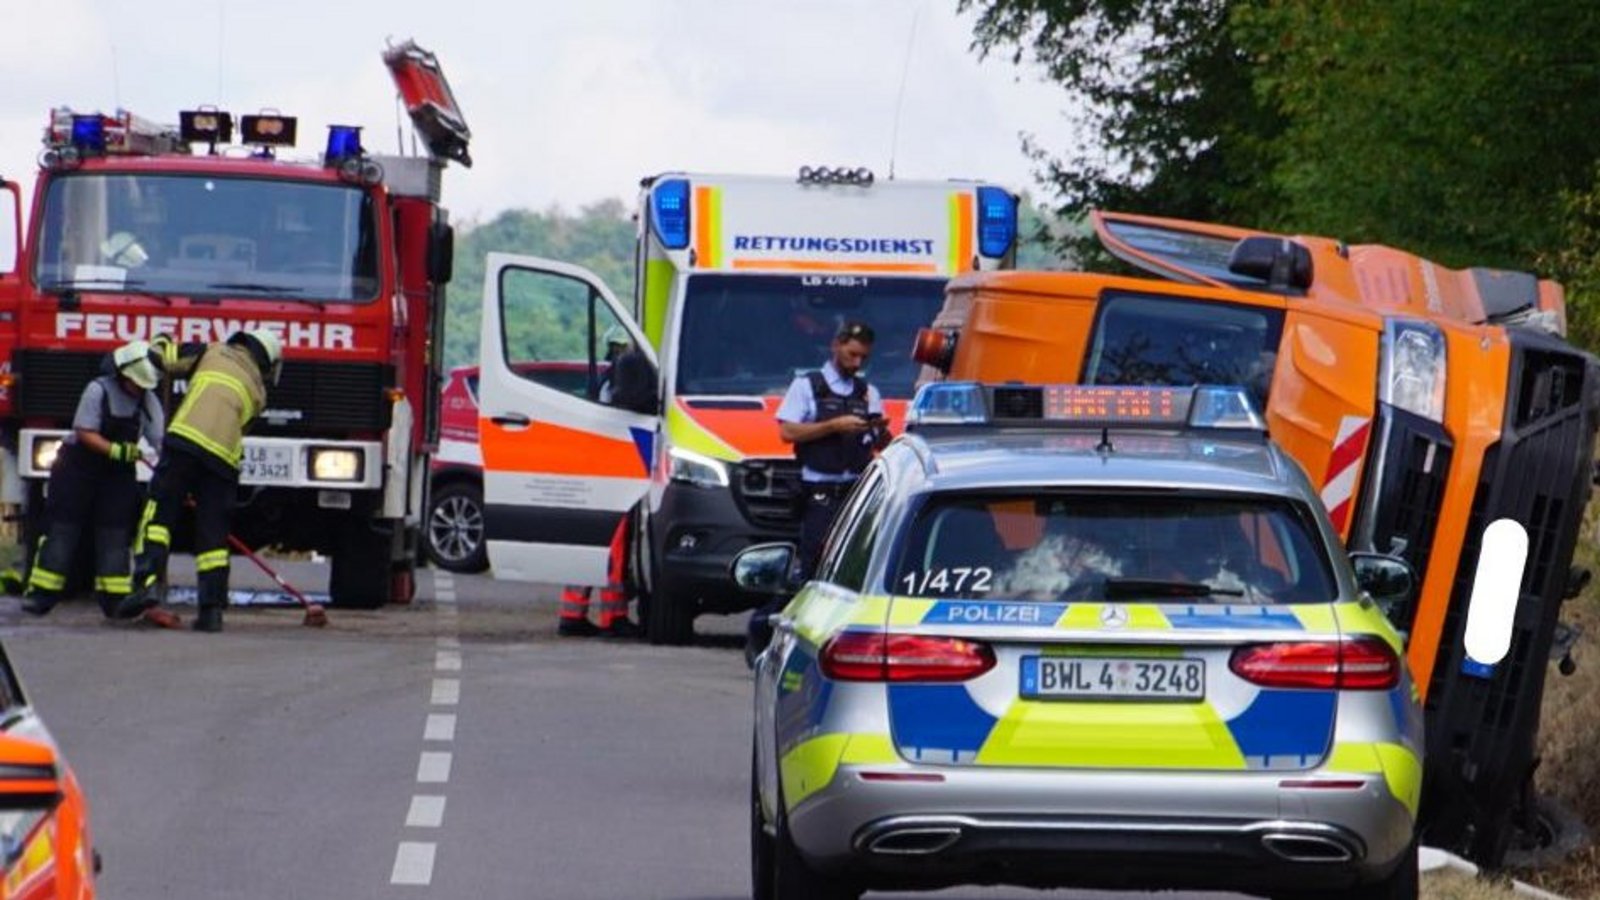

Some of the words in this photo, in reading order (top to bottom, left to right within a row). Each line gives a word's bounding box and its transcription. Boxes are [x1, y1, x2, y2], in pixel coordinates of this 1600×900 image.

[734, 235, 935, 255] RETTUNGSDIENST
[55, 312, 354, 350] FEUERWEHR
[249, 447, 267, 462] LB
[903, 567, 993, 595] 1/472
[948, 605, 1040, 622] POLIZEI
[1041, 662, 1091, 690] BWL
[1099, 662, 1113, 690] 4
[1134, 663, 1200, 692] 3248
